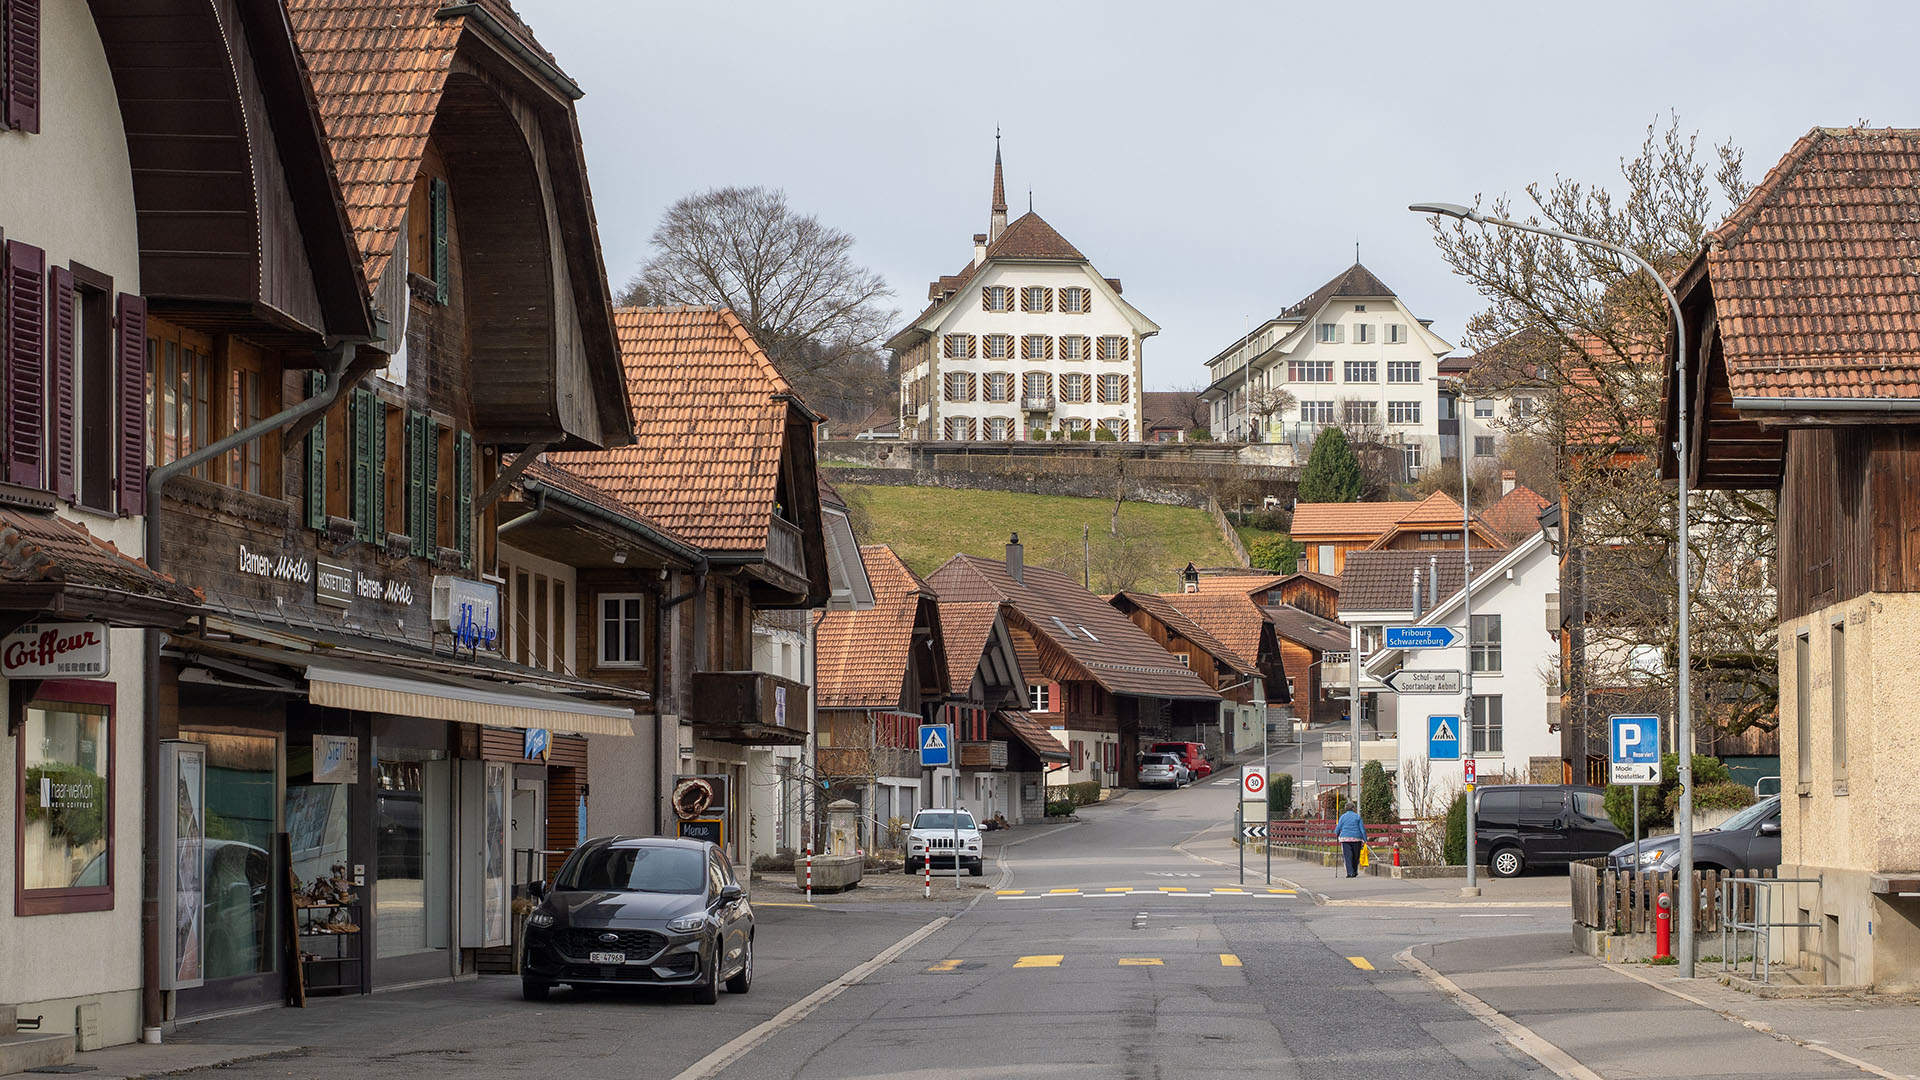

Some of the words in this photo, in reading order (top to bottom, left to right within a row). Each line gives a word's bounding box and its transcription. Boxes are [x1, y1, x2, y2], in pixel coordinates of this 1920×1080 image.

[239, 544, 273, 577] Damen-
[273, 555, 311, 584] Mode
[318, 571, 352, 594] HOSTETTLER
[357, 571, 383, 600] Herren-
[384, 579, 414, 606] Mode
[1401, 629, 1431, 638] Fribourg
[1389, 638, 1443, 646] Schwarzenburg
[4, 629, 101, 669] Coiffeur
[57, 662, 100, 672] HERREN
[1413, 673, 1432, 681] Schul-
[1435, 673, 1445, 681] und
[1401, 682, 1436, 691] Sportanlage
[1437, 682, 1456, 690] Aebnit
[1619, 724, 1641, 758] P
[1250, 779, 1259, 787] 30
[66, 801, 93, 809] COIFFEUR
[683, 823, 710, 837] Menue
